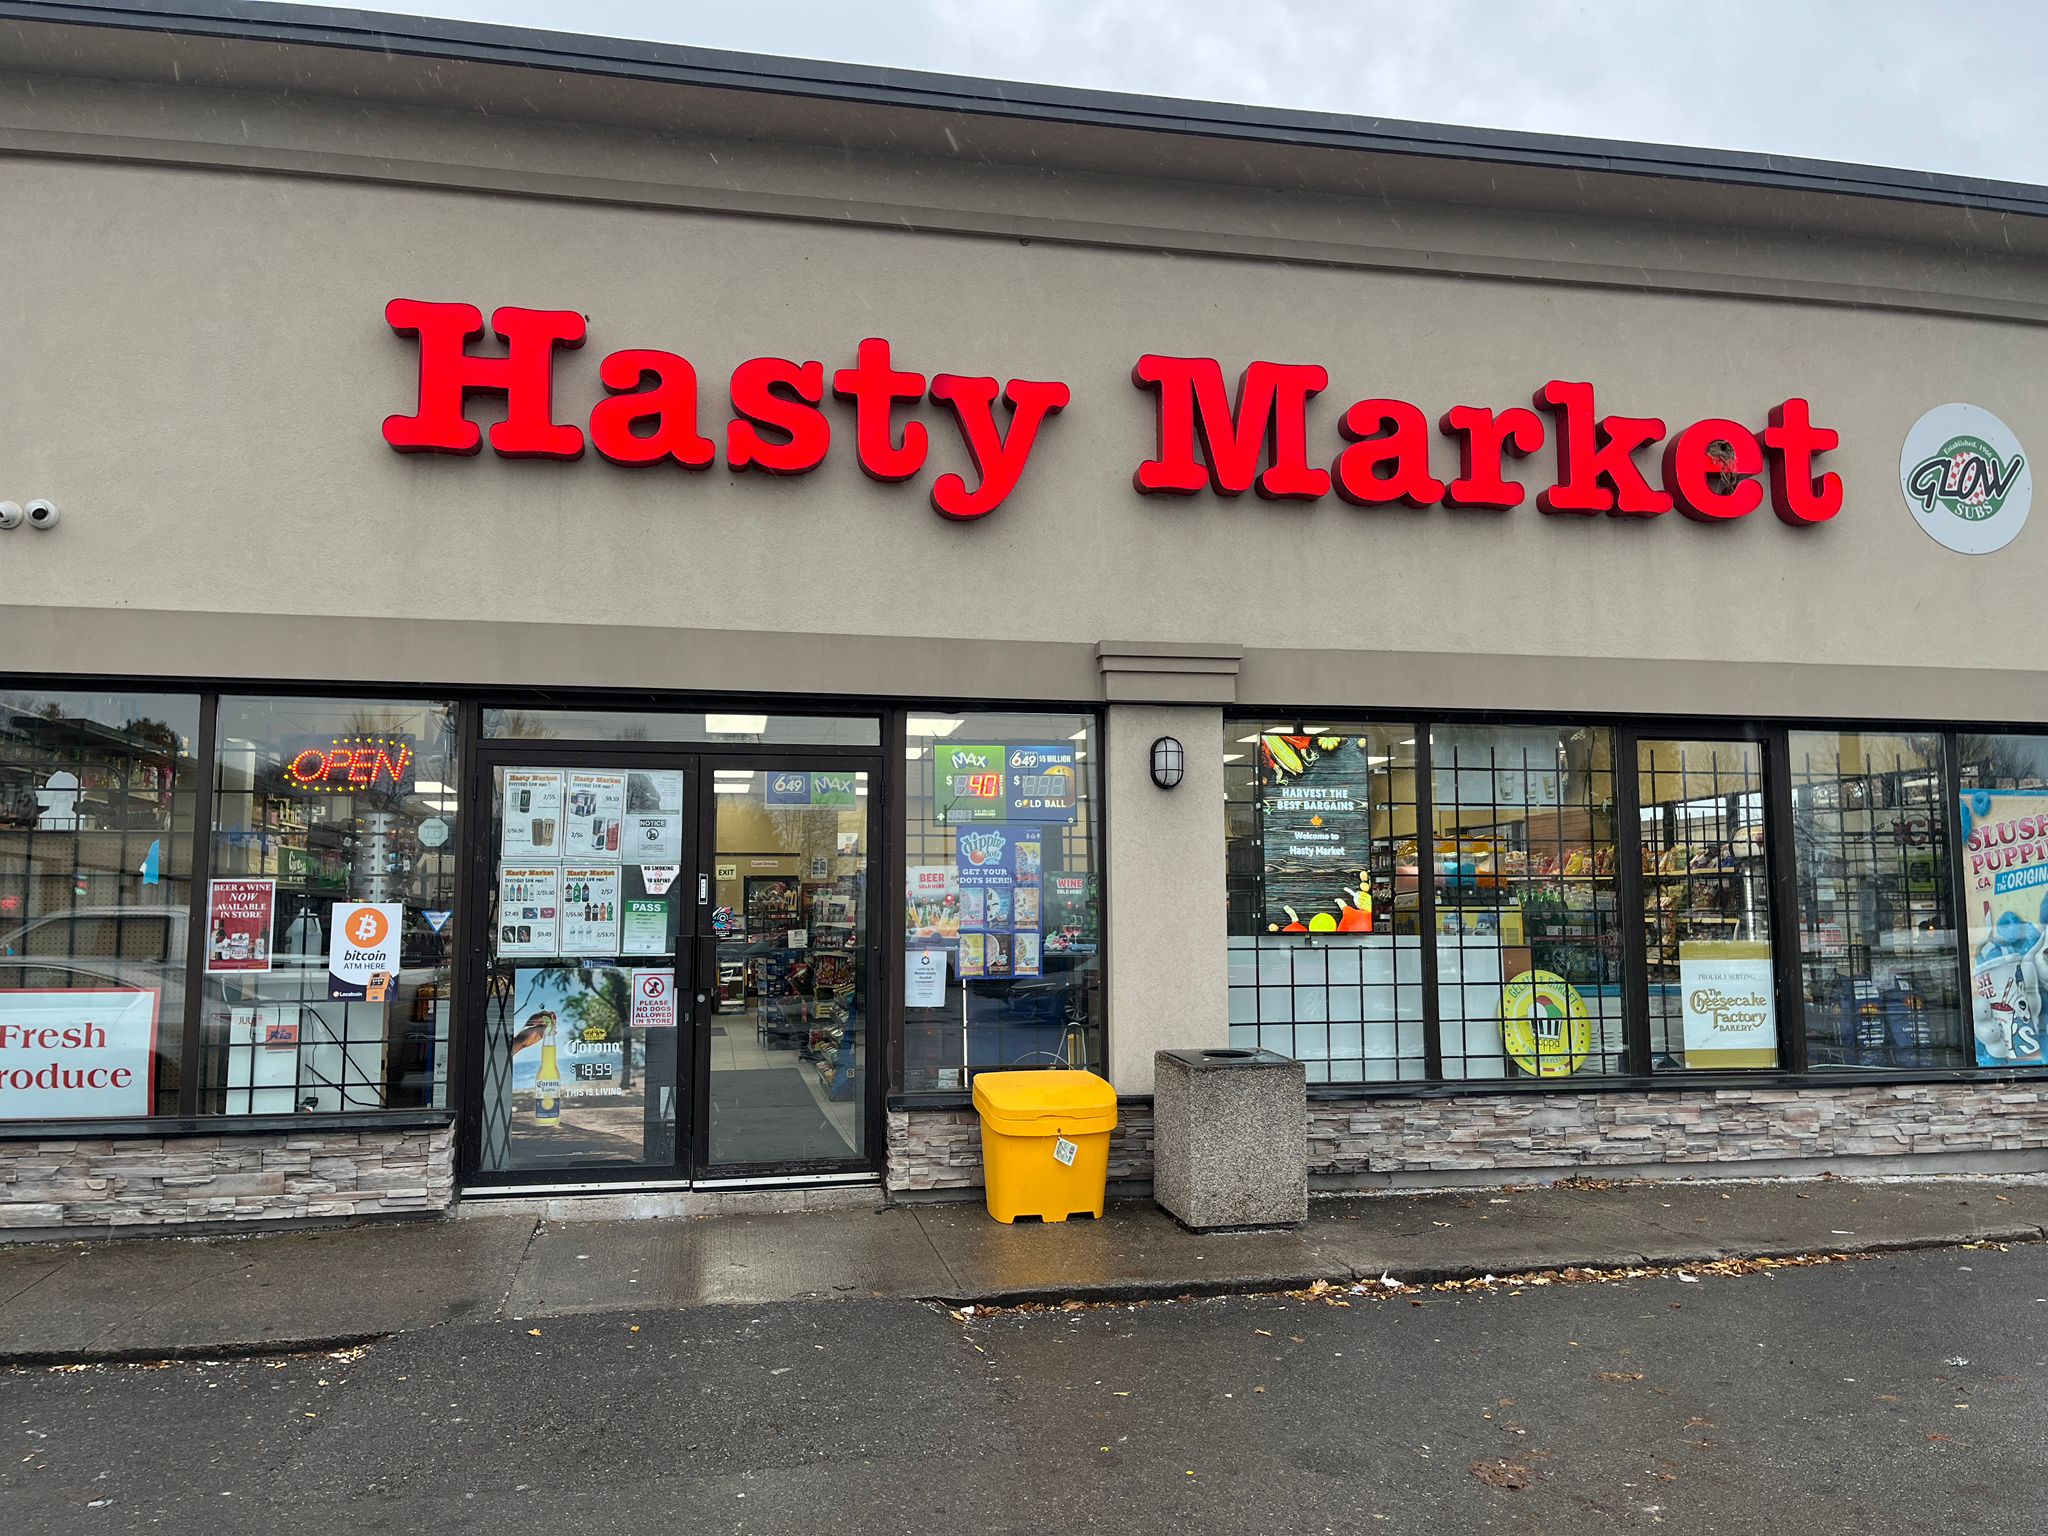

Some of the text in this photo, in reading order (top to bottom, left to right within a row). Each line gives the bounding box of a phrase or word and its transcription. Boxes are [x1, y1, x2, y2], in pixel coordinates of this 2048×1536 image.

[382, 298, 1843, 527] Hasty Market
[1954, 502, 1993, 519] SUBS
[952, 752, 986, 769] MAX
[1047, 755, 1071, 763] MILLION
[291, 748, 408, 782] OPEN
[814, 776, 851, 794] MAX
[969, 775, 997, 797] 40
[1282, 788, 1349, 799] HARVEST THE
[1044, 800, 1067, 808] BALL
[1277, 800, 1355, 811] BEST BARGAINS
[1295, 831, 1330, 840] Welcome
[1289, 846, 1346, 857] Hasty Market
[919, 873, 945, 882] BEER
[1057, 878, 1083, 888] WINE
[229, 893, 258, 902] NOW
[216, 903, 267, 911] AVAILABLE
[632, 903, 662, 912] PASS
[220, 911, 263, 919] IN STORE
[344, 950, 387, 961] bitcoin
[1707, 988, 1722, 998] The
[1689, 989, 1767, 1015] Cheesecake
[1706, 1005, 1767, 1029] Factory
[0, 1022, 107, 1049] Fresh
[564, 1041, 621, 1057] Corona
[566, 1087, 622, 1097] THIS IS LIVING
